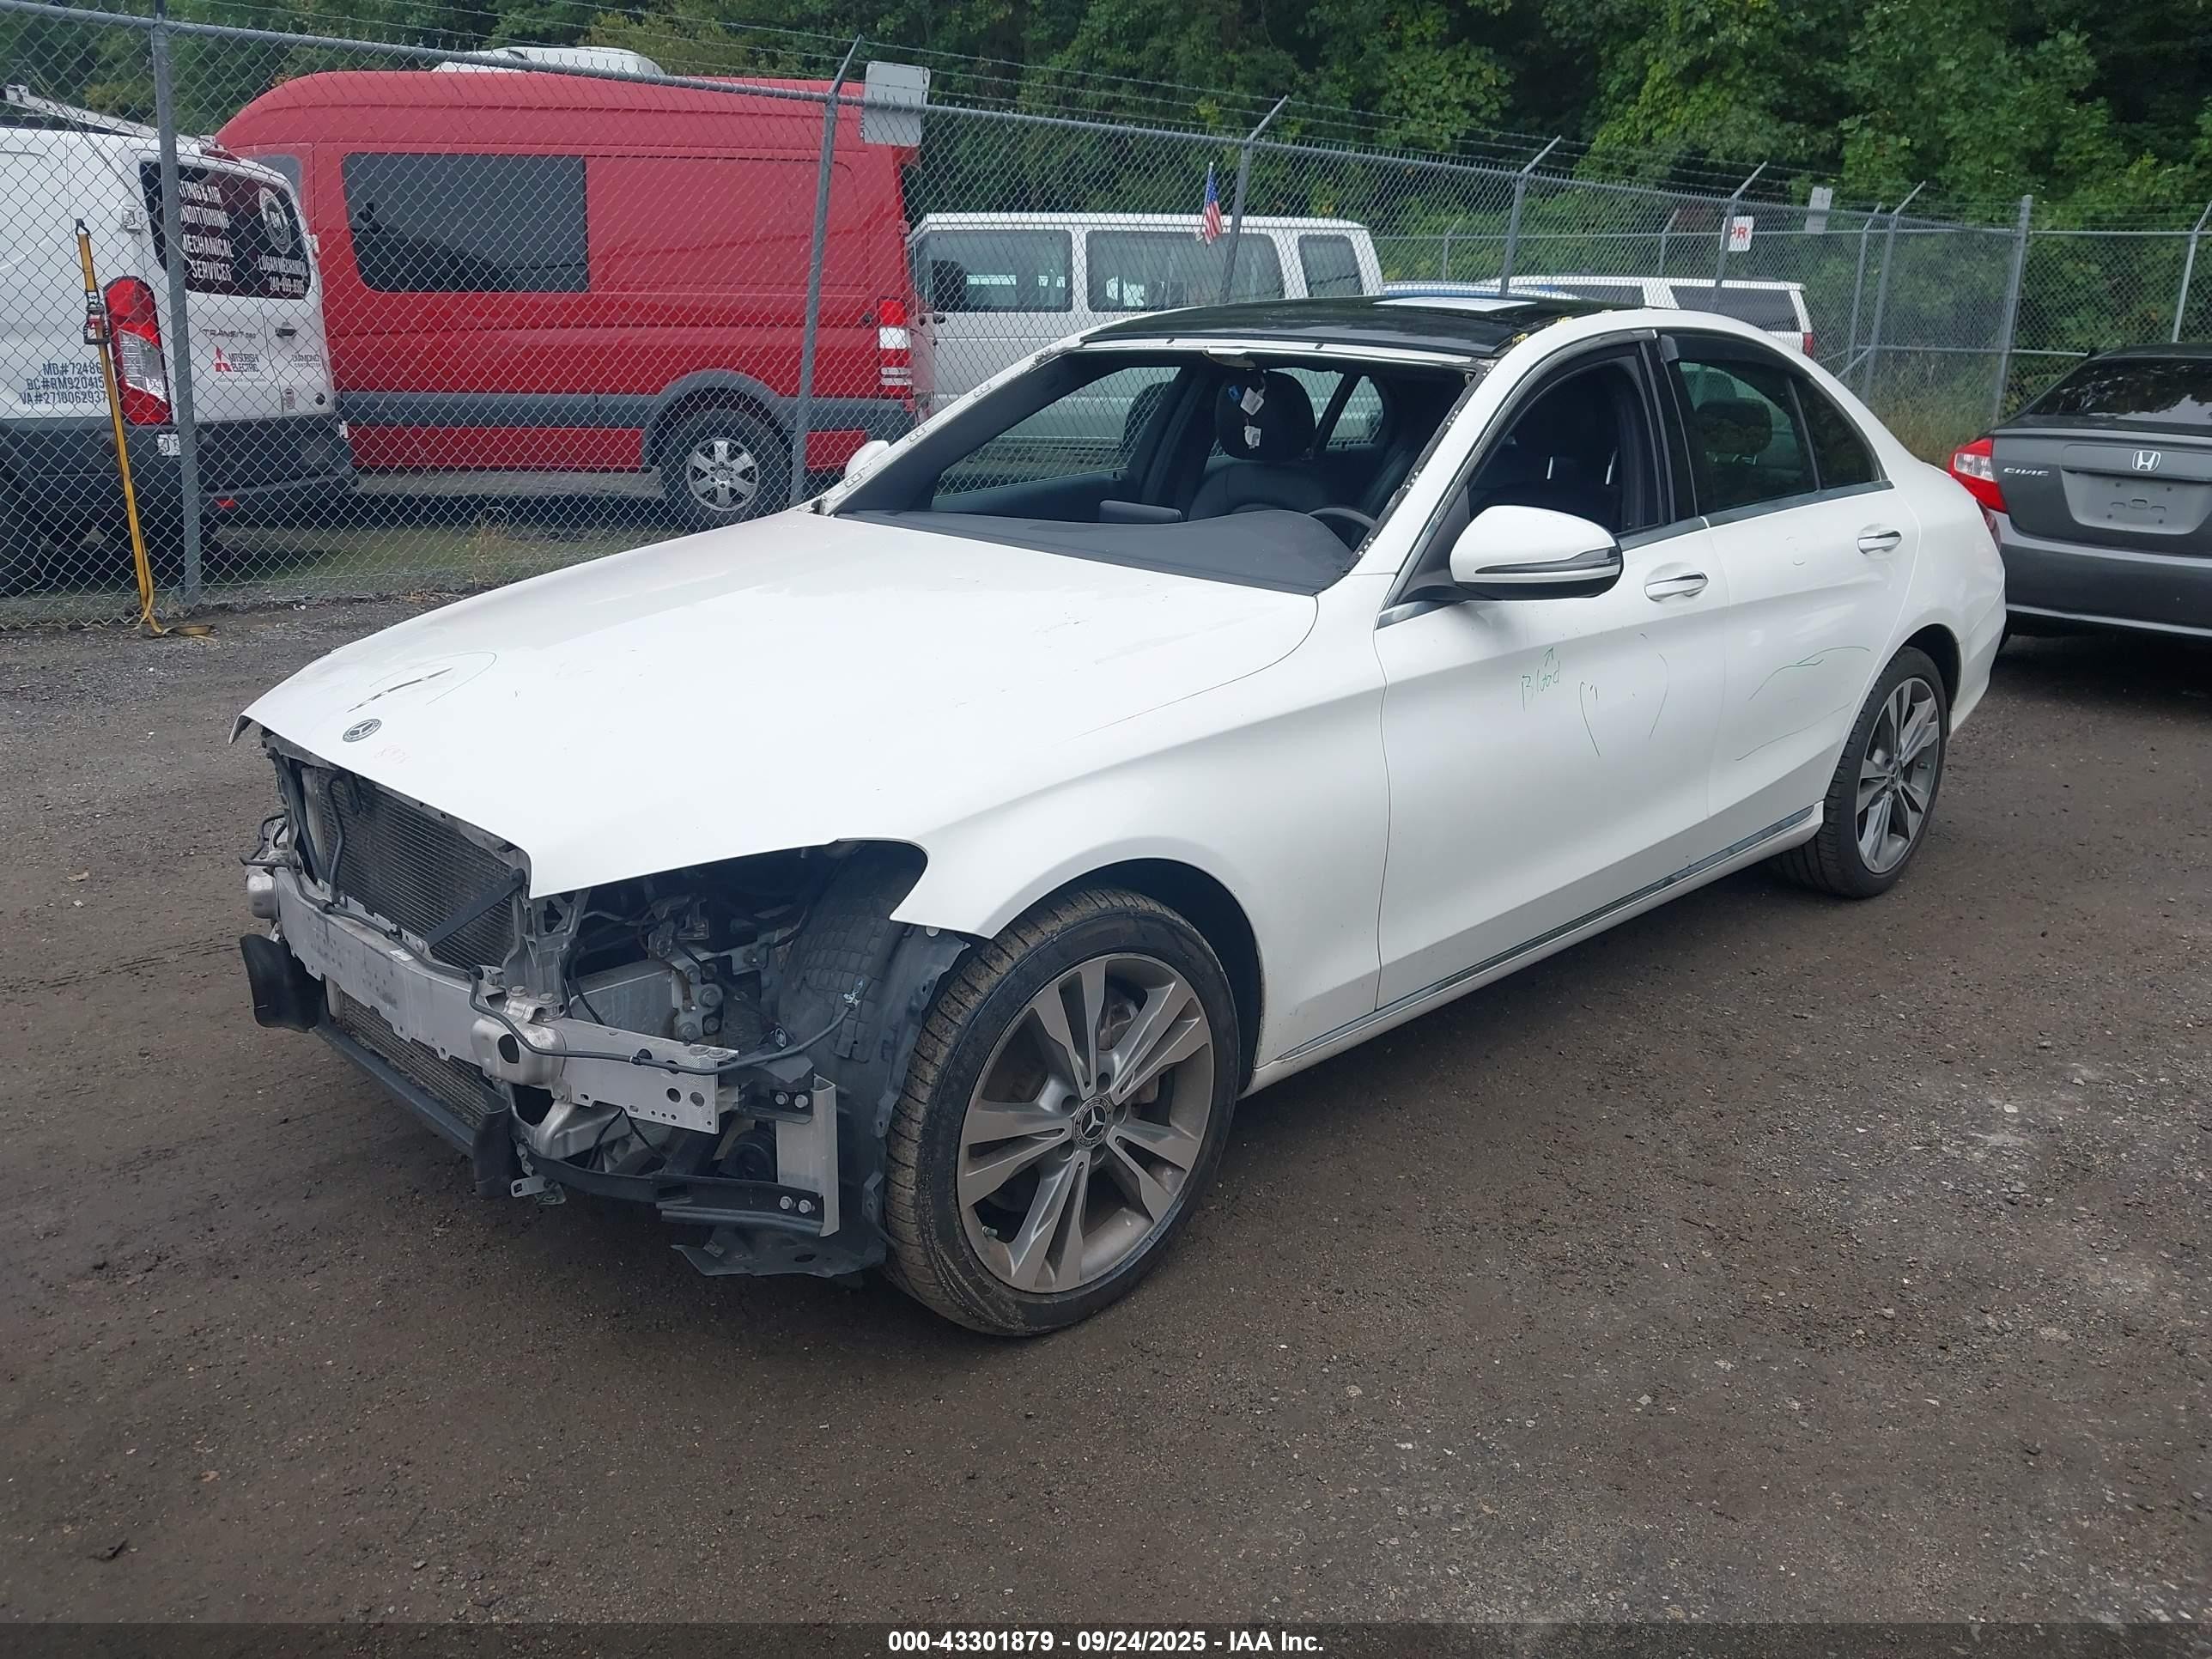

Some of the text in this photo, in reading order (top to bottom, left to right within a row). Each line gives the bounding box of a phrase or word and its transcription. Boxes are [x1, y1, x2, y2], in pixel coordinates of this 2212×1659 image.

[180, 204, 229, 228] NDITIONING
[181, 234, 234, 258] MECHANICAL
[191, 259, 232, 282] SERVICES
[228, 352, 260, 363] MITSUBISHI
[42, 362, 104, 376] MD#72486
[232, 362, 260, 373] ELECTRIC
[2003, 467, 2050, 477] CIVIC
